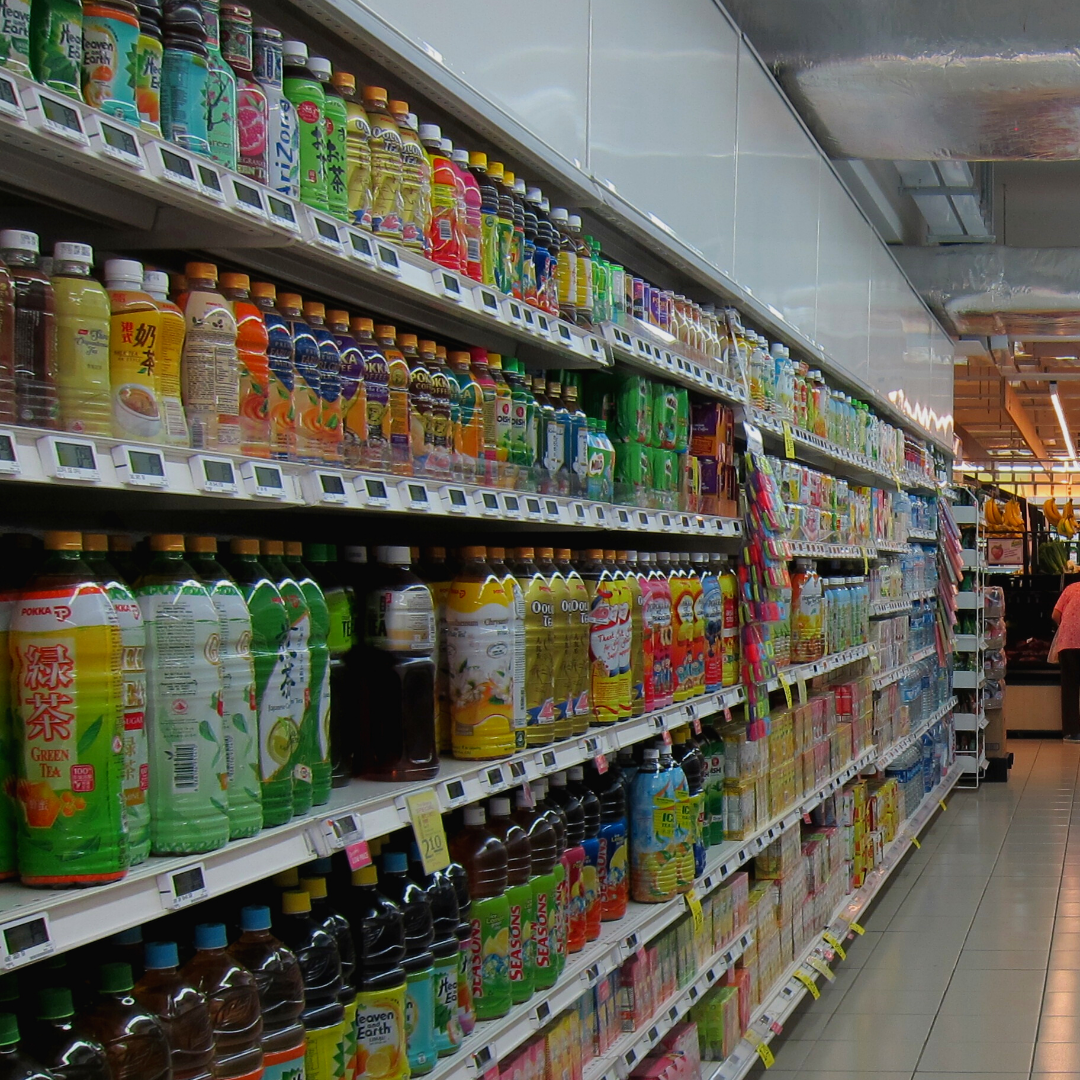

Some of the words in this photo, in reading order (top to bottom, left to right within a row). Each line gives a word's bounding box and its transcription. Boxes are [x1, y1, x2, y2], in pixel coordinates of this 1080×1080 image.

[21, 606, 52, 617] POKKA
[39, 763, 62, 778] TEA
[509, 904, 523, 983] SEASONS
[537, 892, 549, 969] SEASONS
[472, 918, 483, 999] SEASONS
[357, 1023, 393, 1041] Earth
